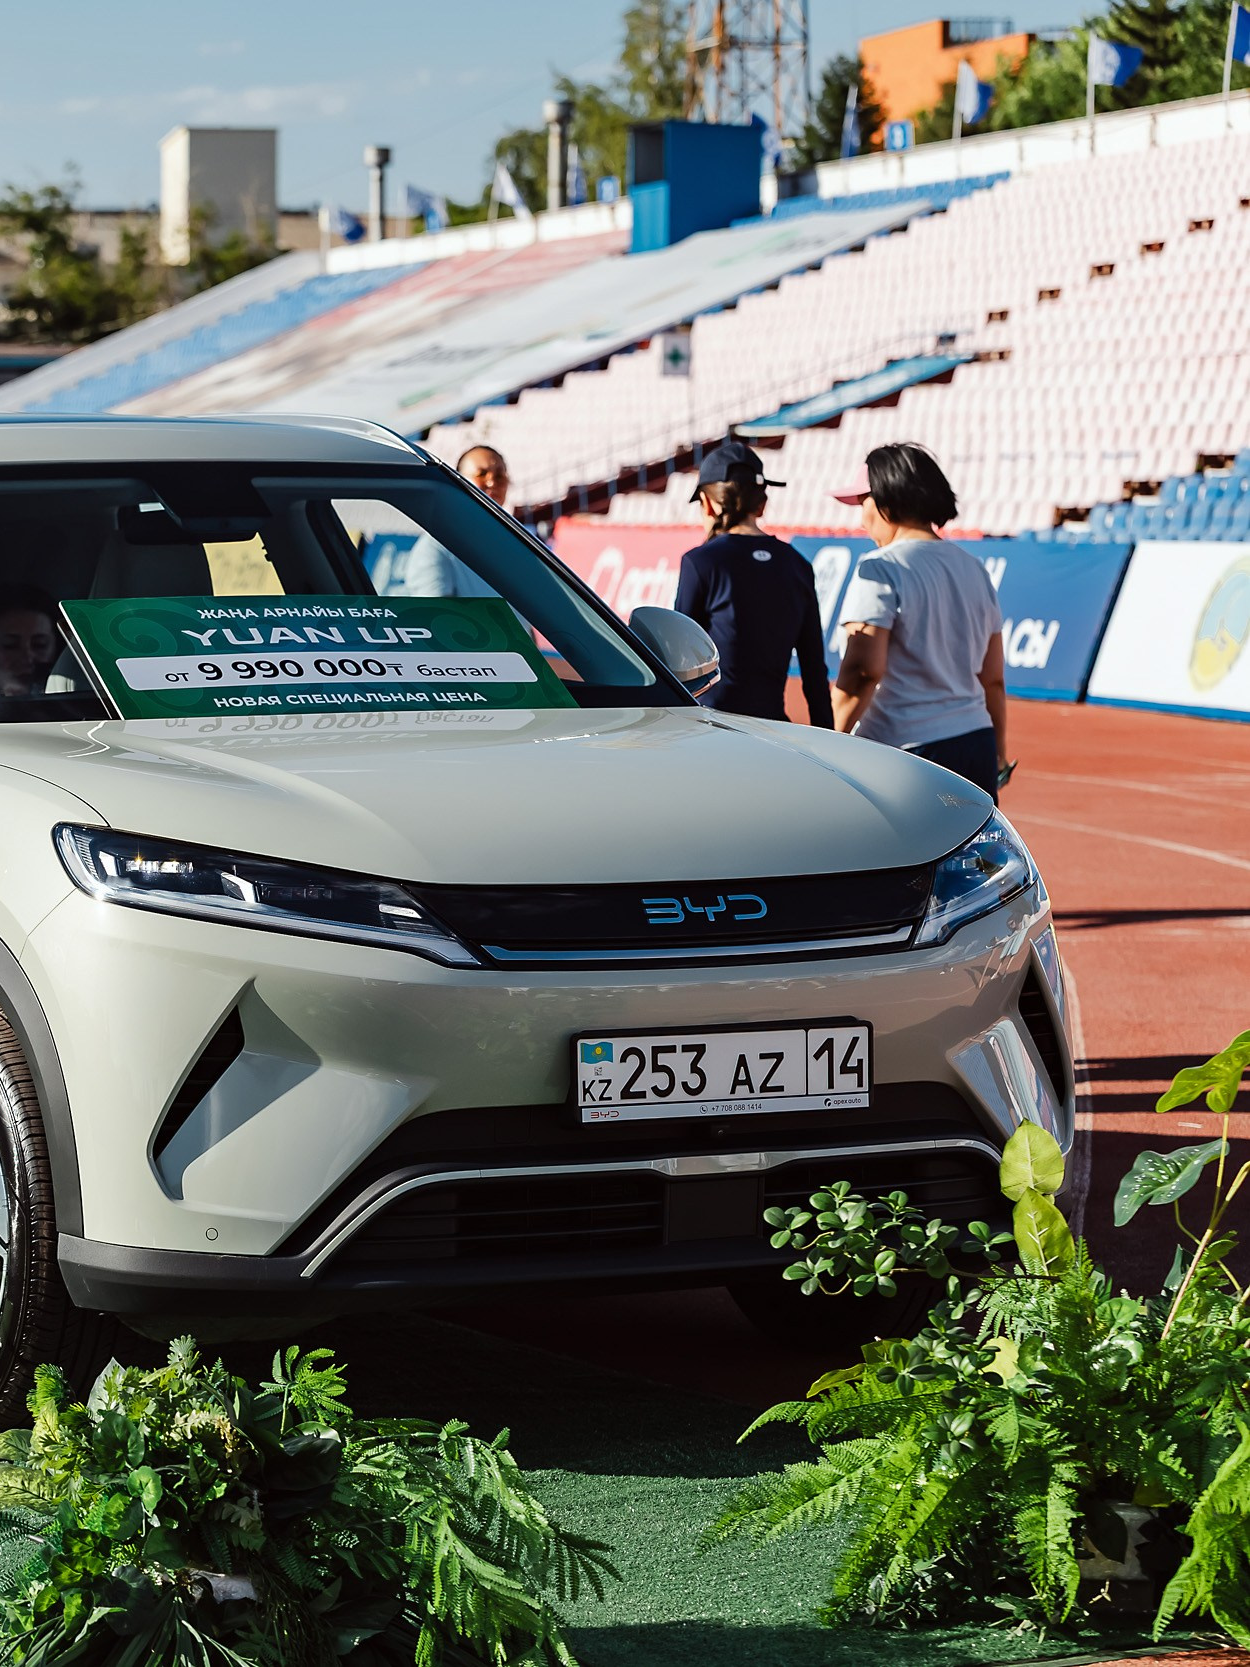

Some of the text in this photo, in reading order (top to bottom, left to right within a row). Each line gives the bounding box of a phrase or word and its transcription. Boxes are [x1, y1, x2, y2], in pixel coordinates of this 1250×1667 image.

[196, 605, 399, 620] ЖАҢА АРНАЙЫ БАҒА
[181, 626, 433, 646] YUAN UP
[164, 672, 190, 682] от
[197, 662, 223, 681] 9
[231, 659, 304, 680] 990
[416, 663, 498, 677] бастап
[213, 691, 488, 709] НОВАЯ СПЕЦИАЛЬНАЯ ЦЕНА
[642, 893, 768, 924] BYD
[619, 1036, 864, 1100] 253 AZ 14
[582, 1078, 613, 1102] KZ
